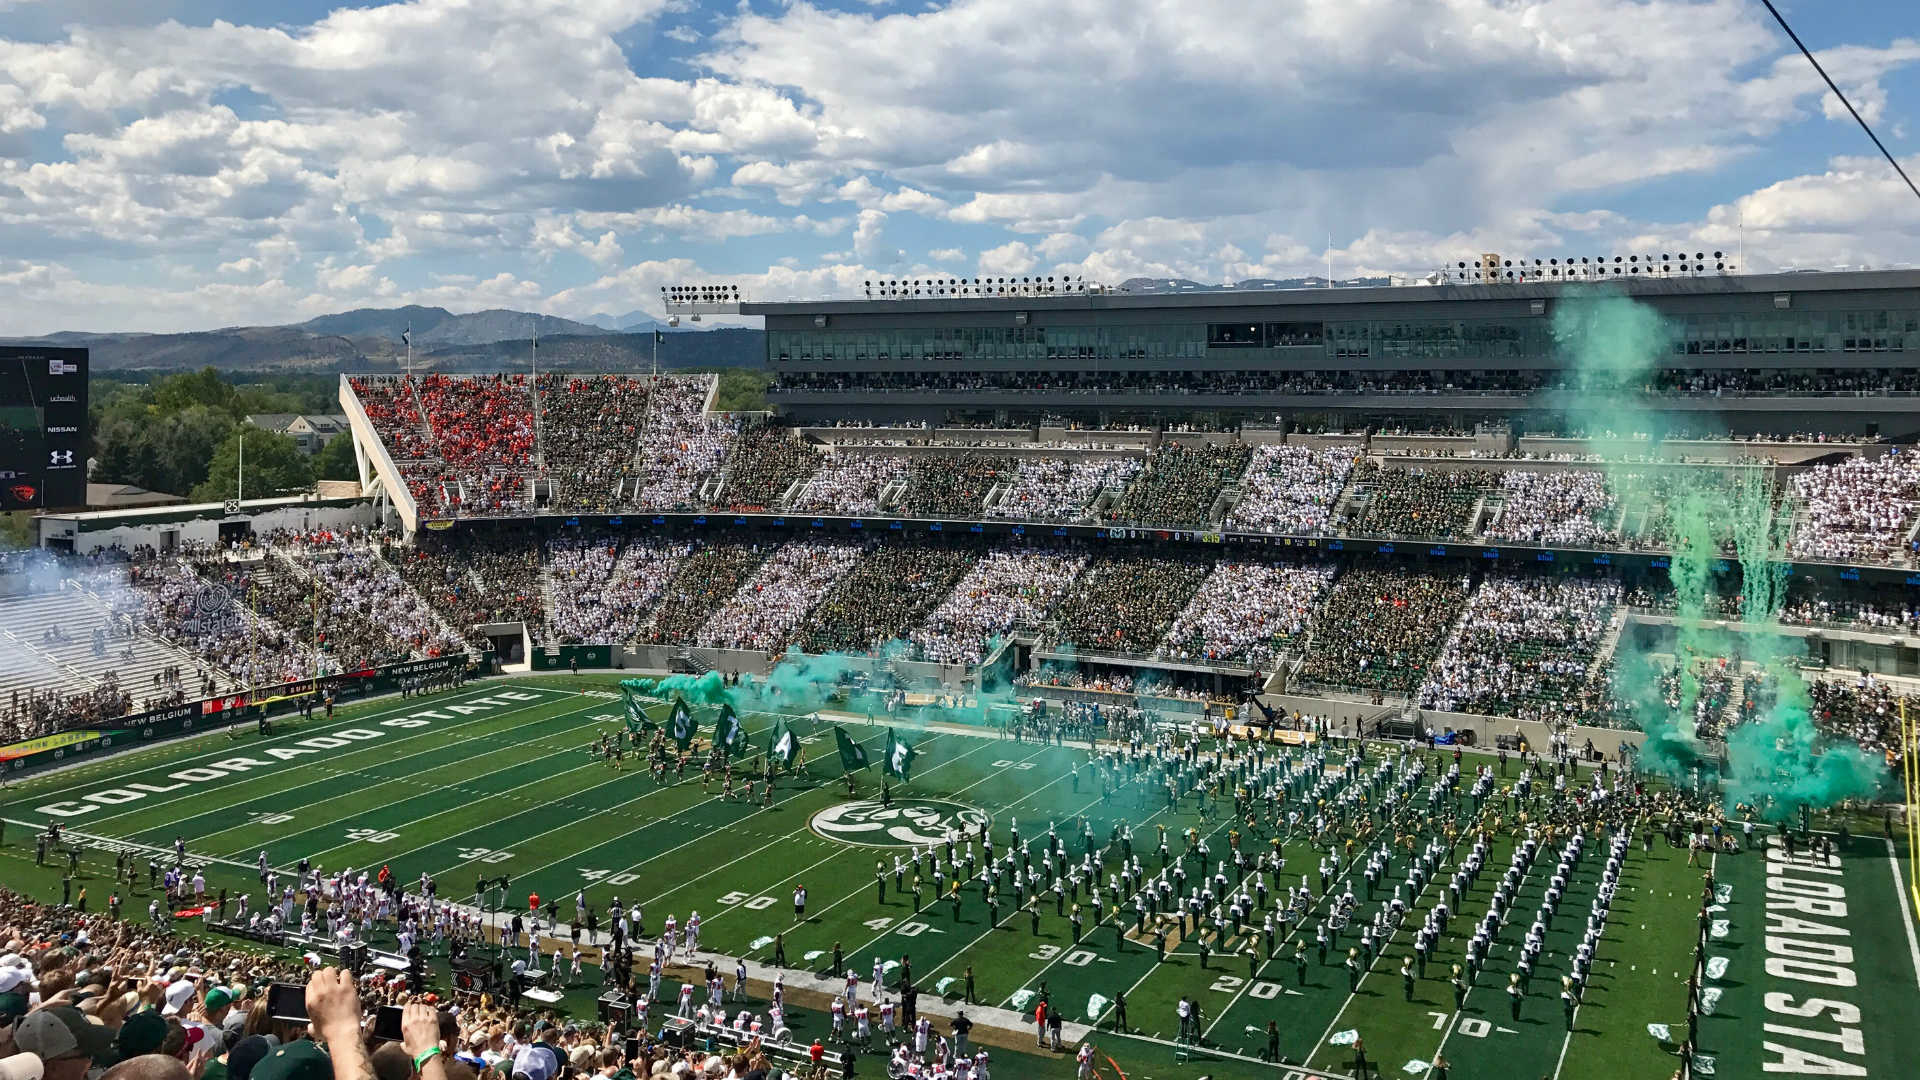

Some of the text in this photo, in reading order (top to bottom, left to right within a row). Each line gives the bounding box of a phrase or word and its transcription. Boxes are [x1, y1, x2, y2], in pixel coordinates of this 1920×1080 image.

[1202, 533, 1220, 543] 3:15
[181, 614, 234, 633] Allstate
[391, 660, 449, 675] NEW BELGIUM
[123, 707, 192, 728] NEW BELGIUM
[34, 691, 540, 818] COLORADO STATE
[344, 829, 401, 843] 20
[458, 848, 516, 864] 30
[579, 869, 641, 886] 40
[716, 890, 779, 910] 50
[862, 917, 930, 937] 40
[1028, 944, 1098, 967] 30
[1209, 975, 1283, 1000] 20
[1426, 1011, 1492, 1038] 10
